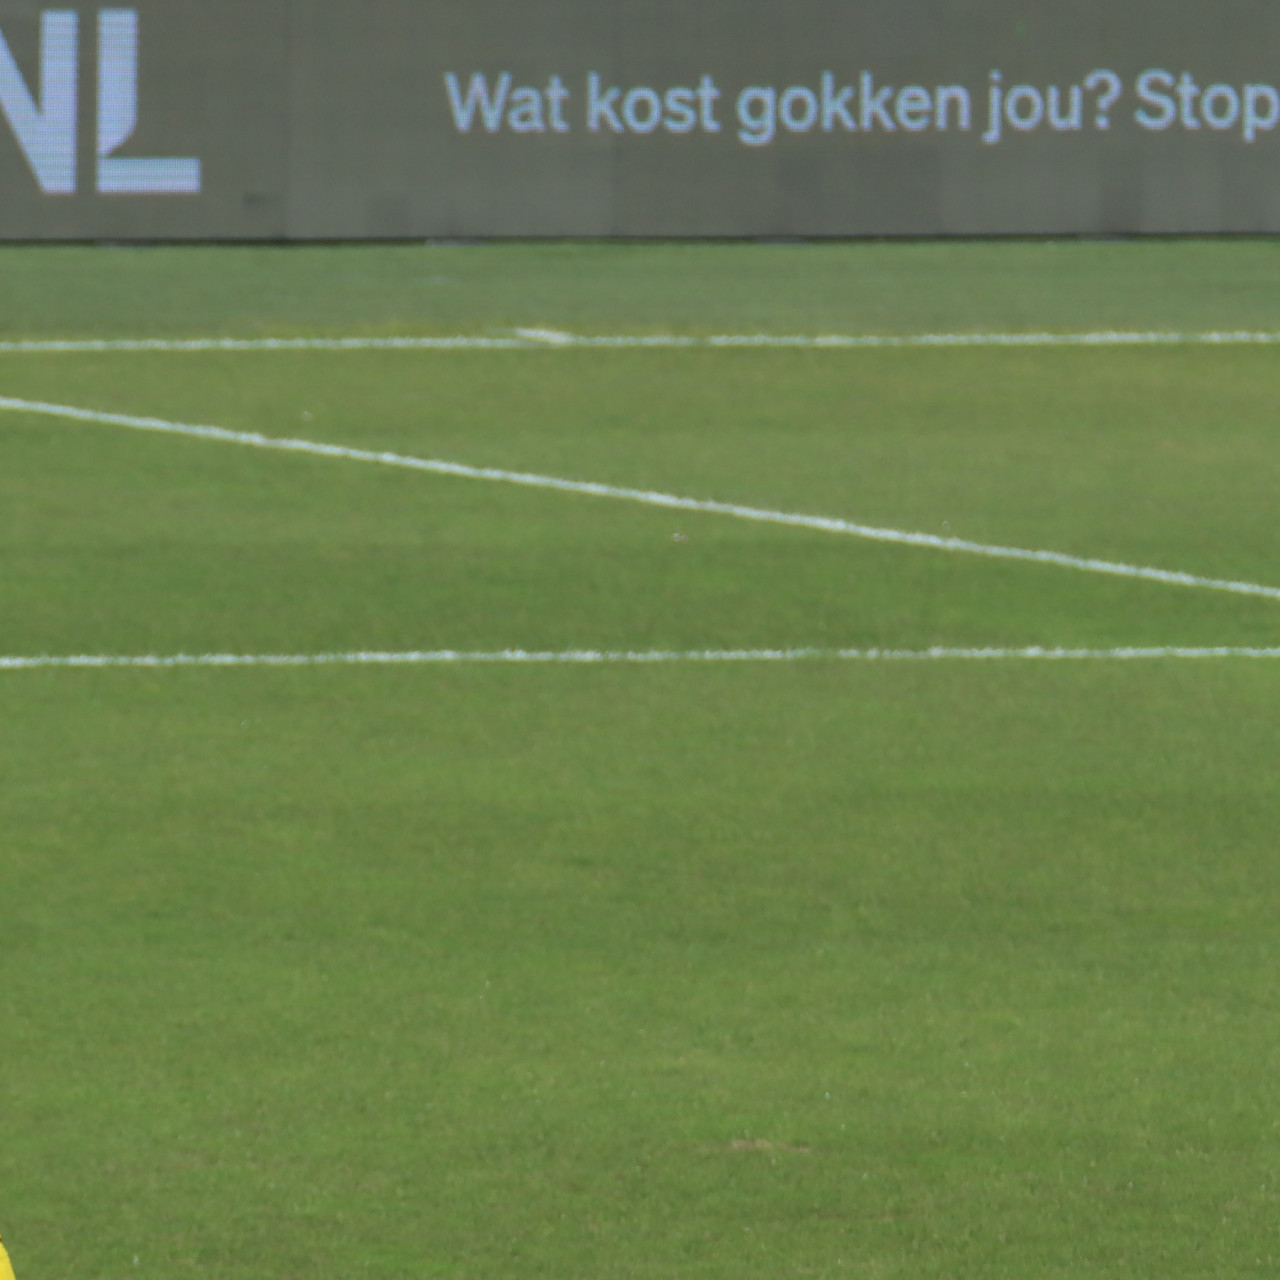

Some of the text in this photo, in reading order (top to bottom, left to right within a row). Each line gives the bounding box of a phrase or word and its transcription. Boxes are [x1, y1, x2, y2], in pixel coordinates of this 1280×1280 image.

[444, 69, 1280, 145] Wat kost gokken jou? Stop
